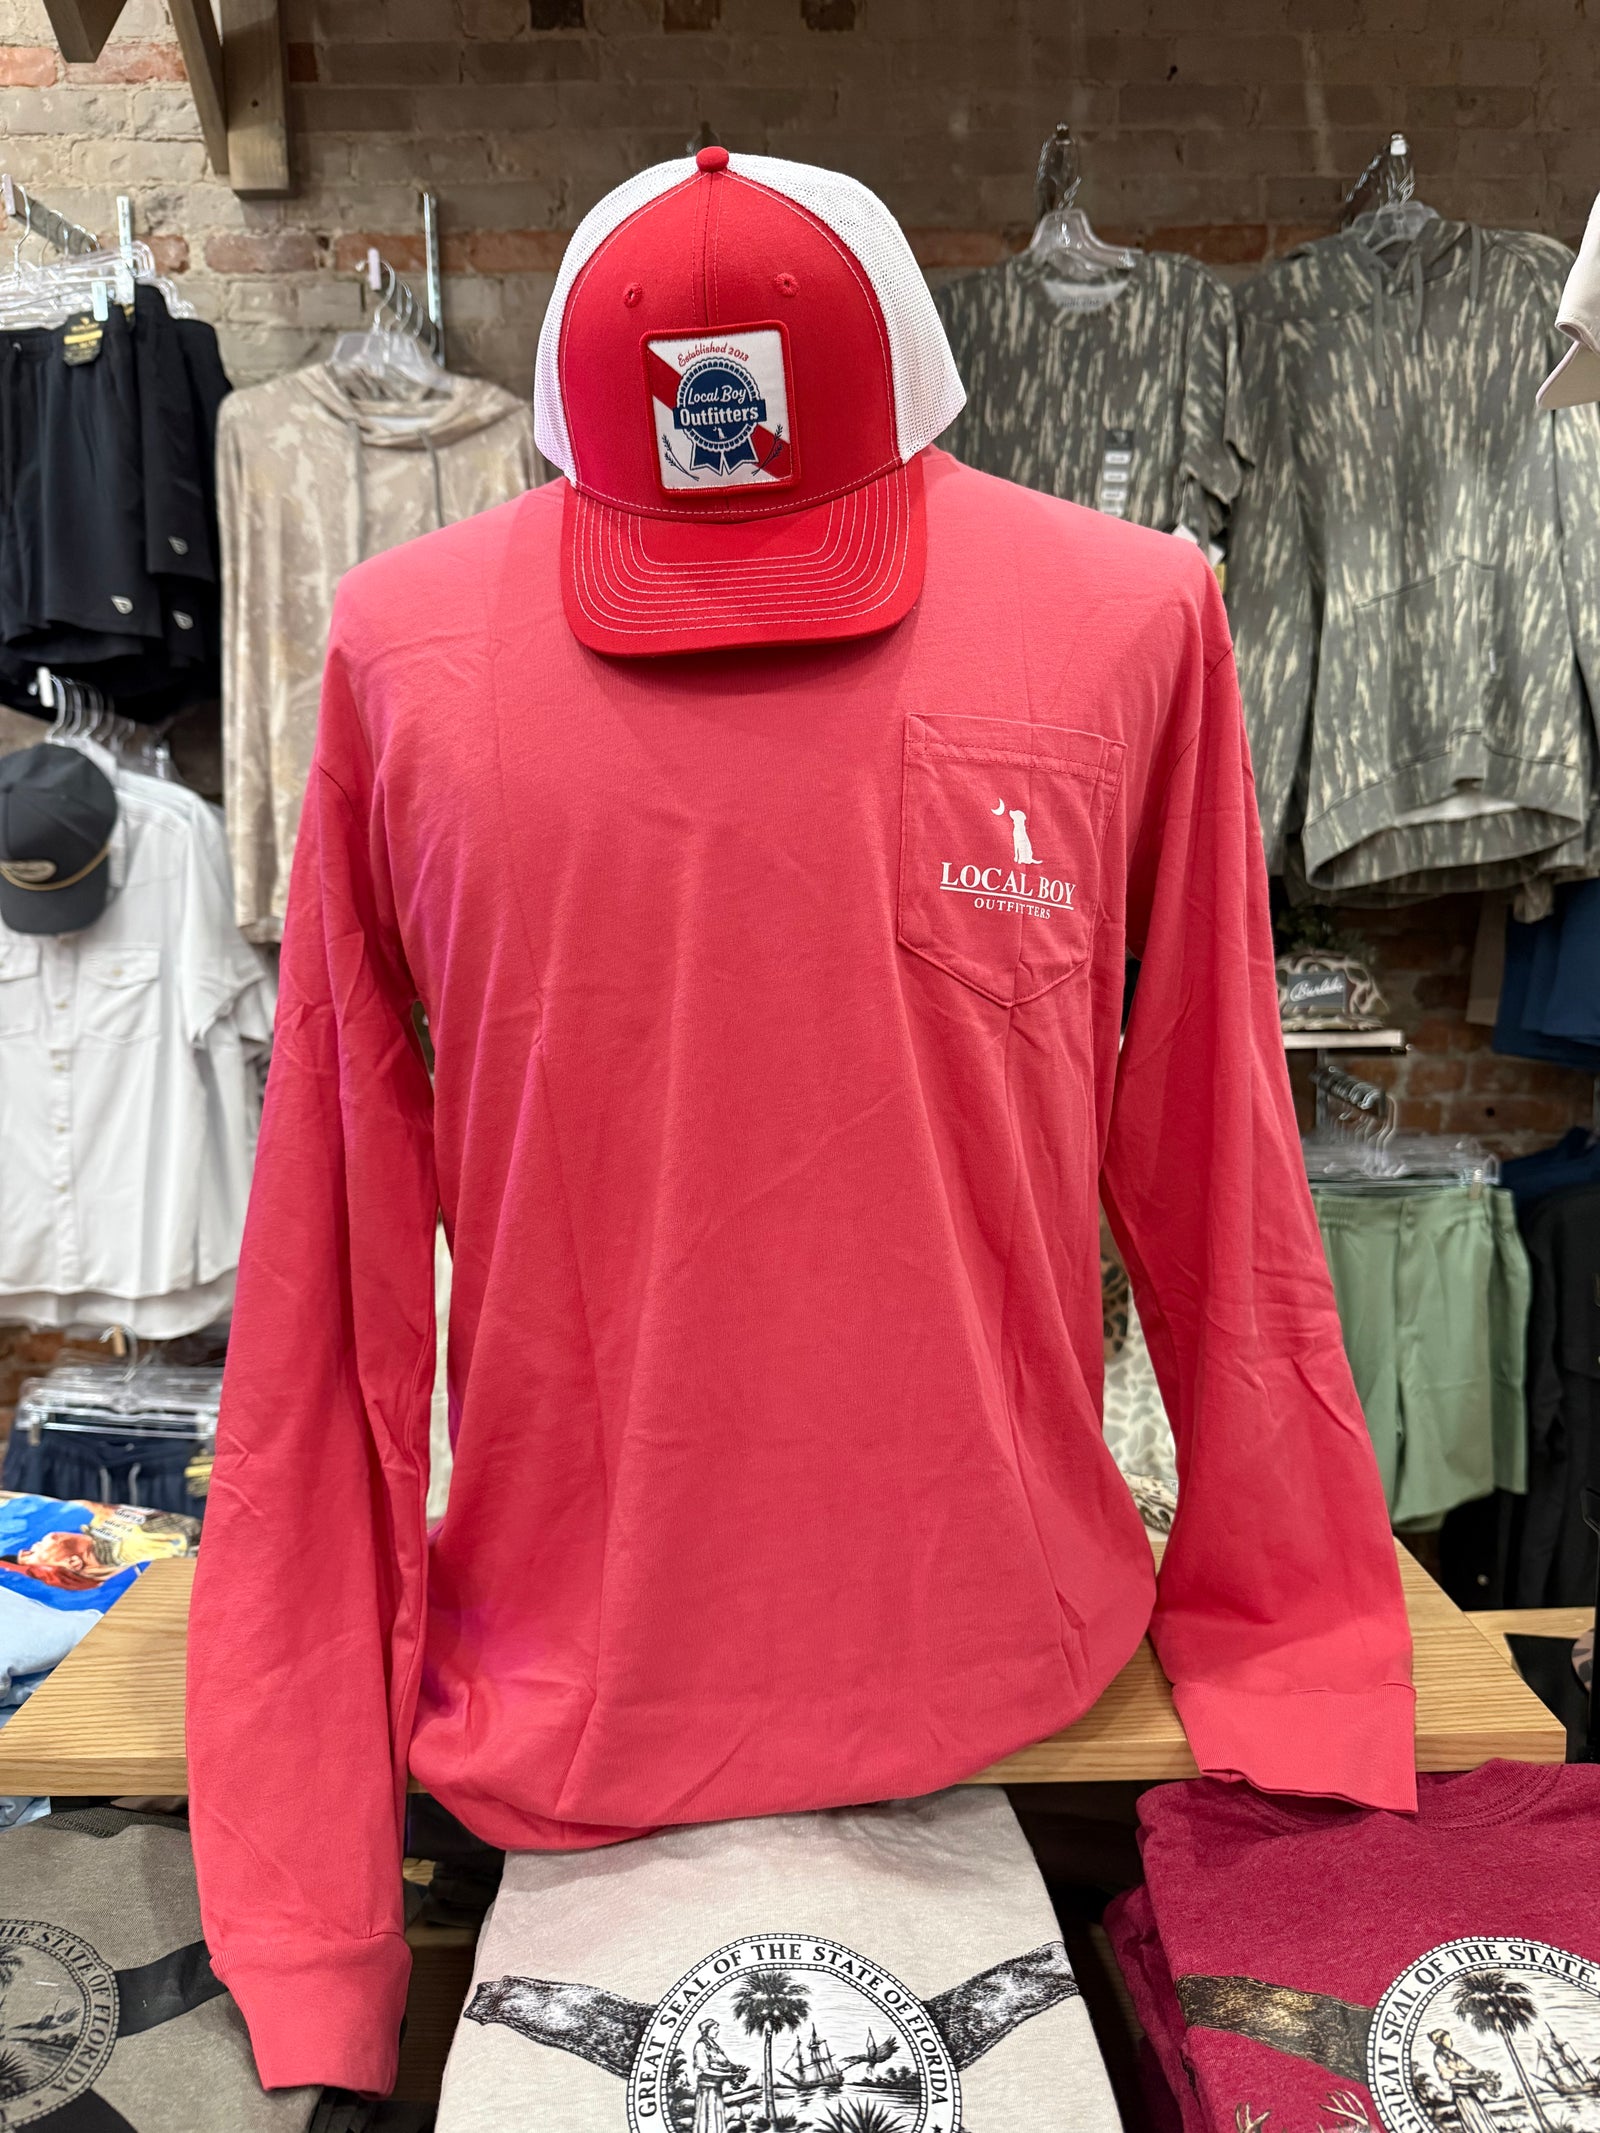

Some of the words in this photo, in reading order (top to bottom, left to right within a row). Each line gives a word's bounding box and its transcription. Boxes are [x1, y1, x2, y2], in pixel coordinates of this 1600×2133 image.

[677, 341, 727, 367] Established
[728, 348, 749, 362] 2013
[687, 387, 719, 405] Local
[720, 384, 747, 404] Boy
[680, 406, 759, 426] Outfitters
[940, 861, 1033, 896] LOCAL
[1037, 876, 1076, 904] BOY
[974, 897, 1050, 920] OUTFITTERS
[36, 1931, 98, 1976] STATE
[87, 1974, 111, 1999] OF
[1414, 1958, 1448, 1985] OF
[1446, 1944, 1501, 1966] THE
[1509, 1944, 1597, 1985] STATE
[638, 2036, 666, 2117] GREAT
[660, 1977, 711, 2028] SEAL
[713, 1950, 742, 1974] OF
[751, 1943, 801, 1960] THE
[813, 1946, 883, 1991] STATE
[905, 2014, 948, 2104] FLORIDA
